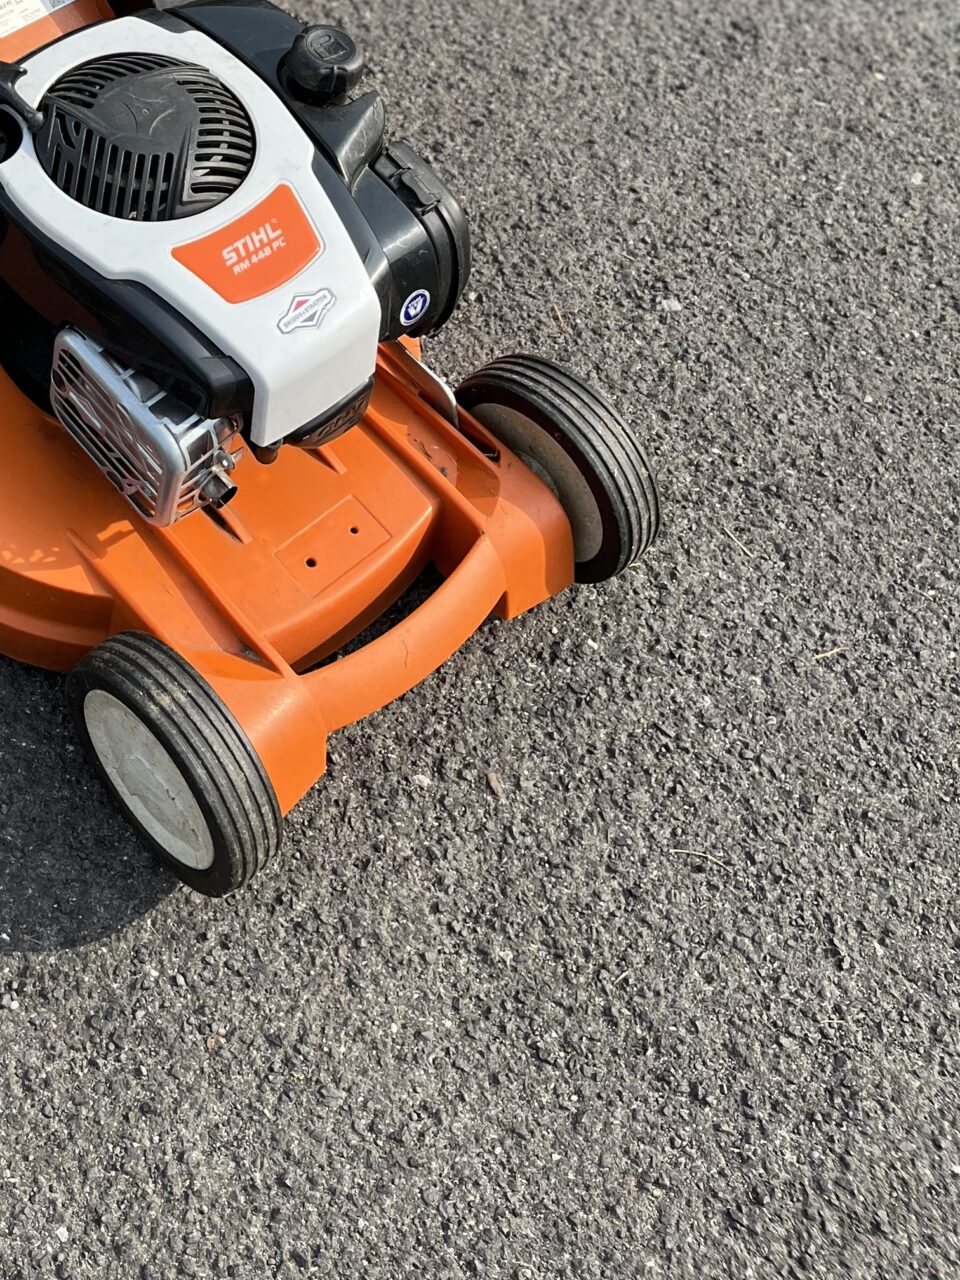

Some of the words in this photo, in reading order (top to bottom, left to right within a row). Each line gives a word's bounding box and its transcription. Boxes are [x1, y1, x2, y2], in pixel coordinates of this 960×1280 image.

[222, 222, 282, 267] STIHL
[232, 259, 251, 276] RM
[251, 246, 272, 263] 448
[272, 236, 287, 252] PC
